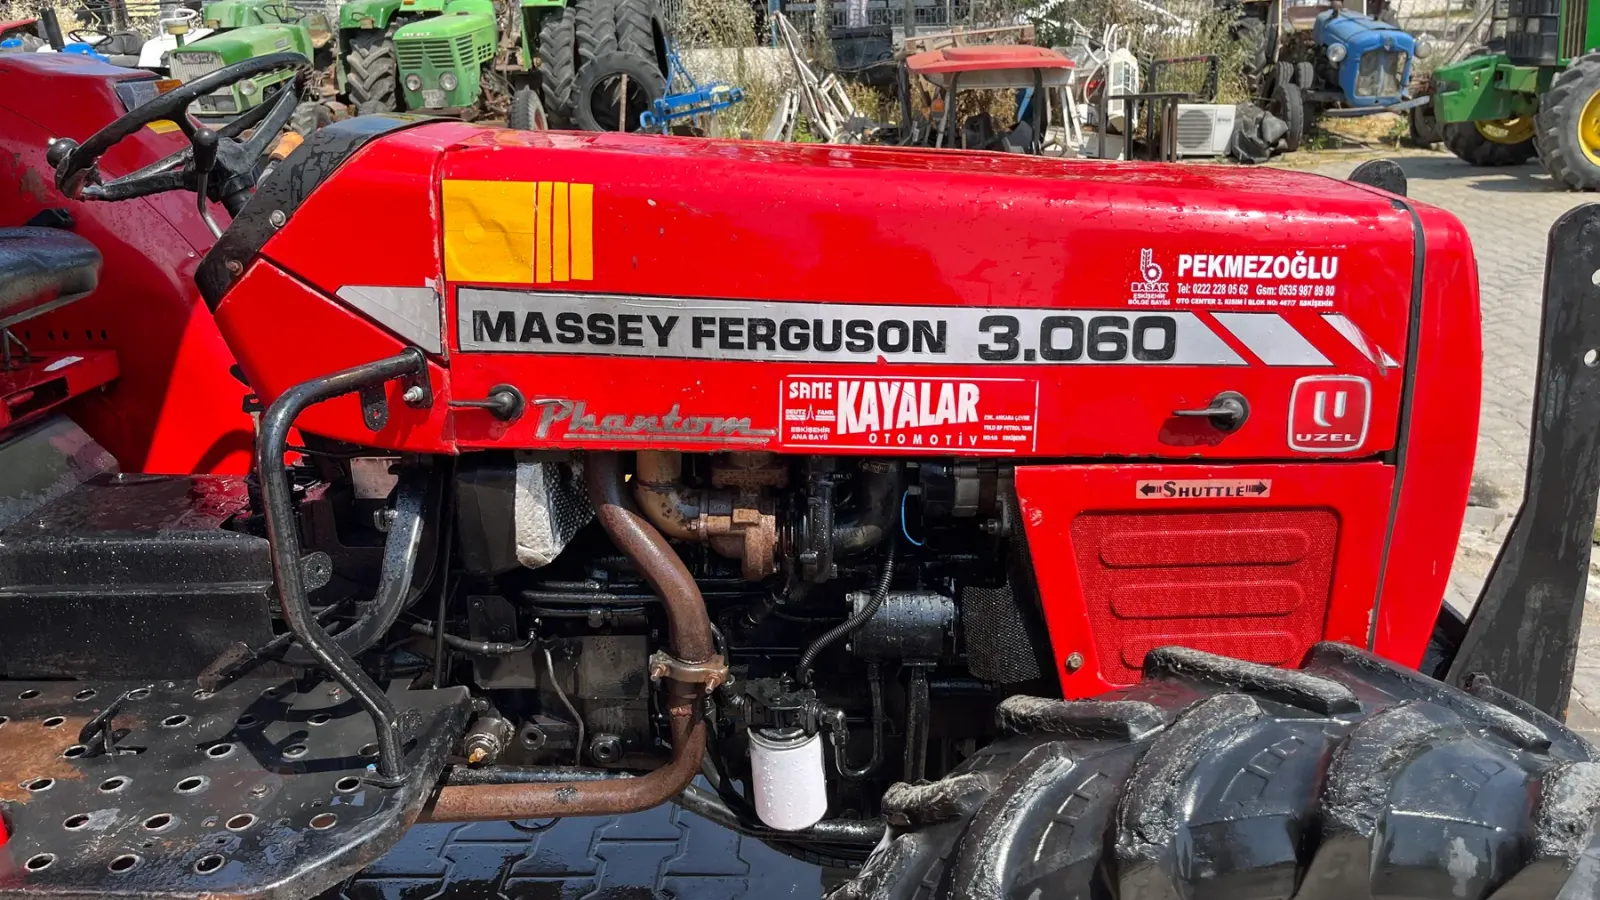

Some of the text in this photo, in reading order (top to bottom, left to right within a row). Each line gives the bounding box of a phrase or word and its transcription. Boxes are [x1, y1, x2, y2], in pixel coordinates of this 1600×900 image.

[1177, 251, 1338, 279] PEKMEZOĞLU
[1177, 283, 1335, 296] Tel: 0222 228 05 62 Gsm: 0535 987 89 80
[472, 310, 947, 354] MASSEY FERGUSON
[977, 315, 1177, 362] 3.060
[789, 381, 832, 399] SAME
[533, 398, 778, 438] Phantom
[837, 380, 980, 435] KAYALAR
[1295, 433, 1357, 442] UZEL
[1163, 480, 1245, 498] SHUTTLE
